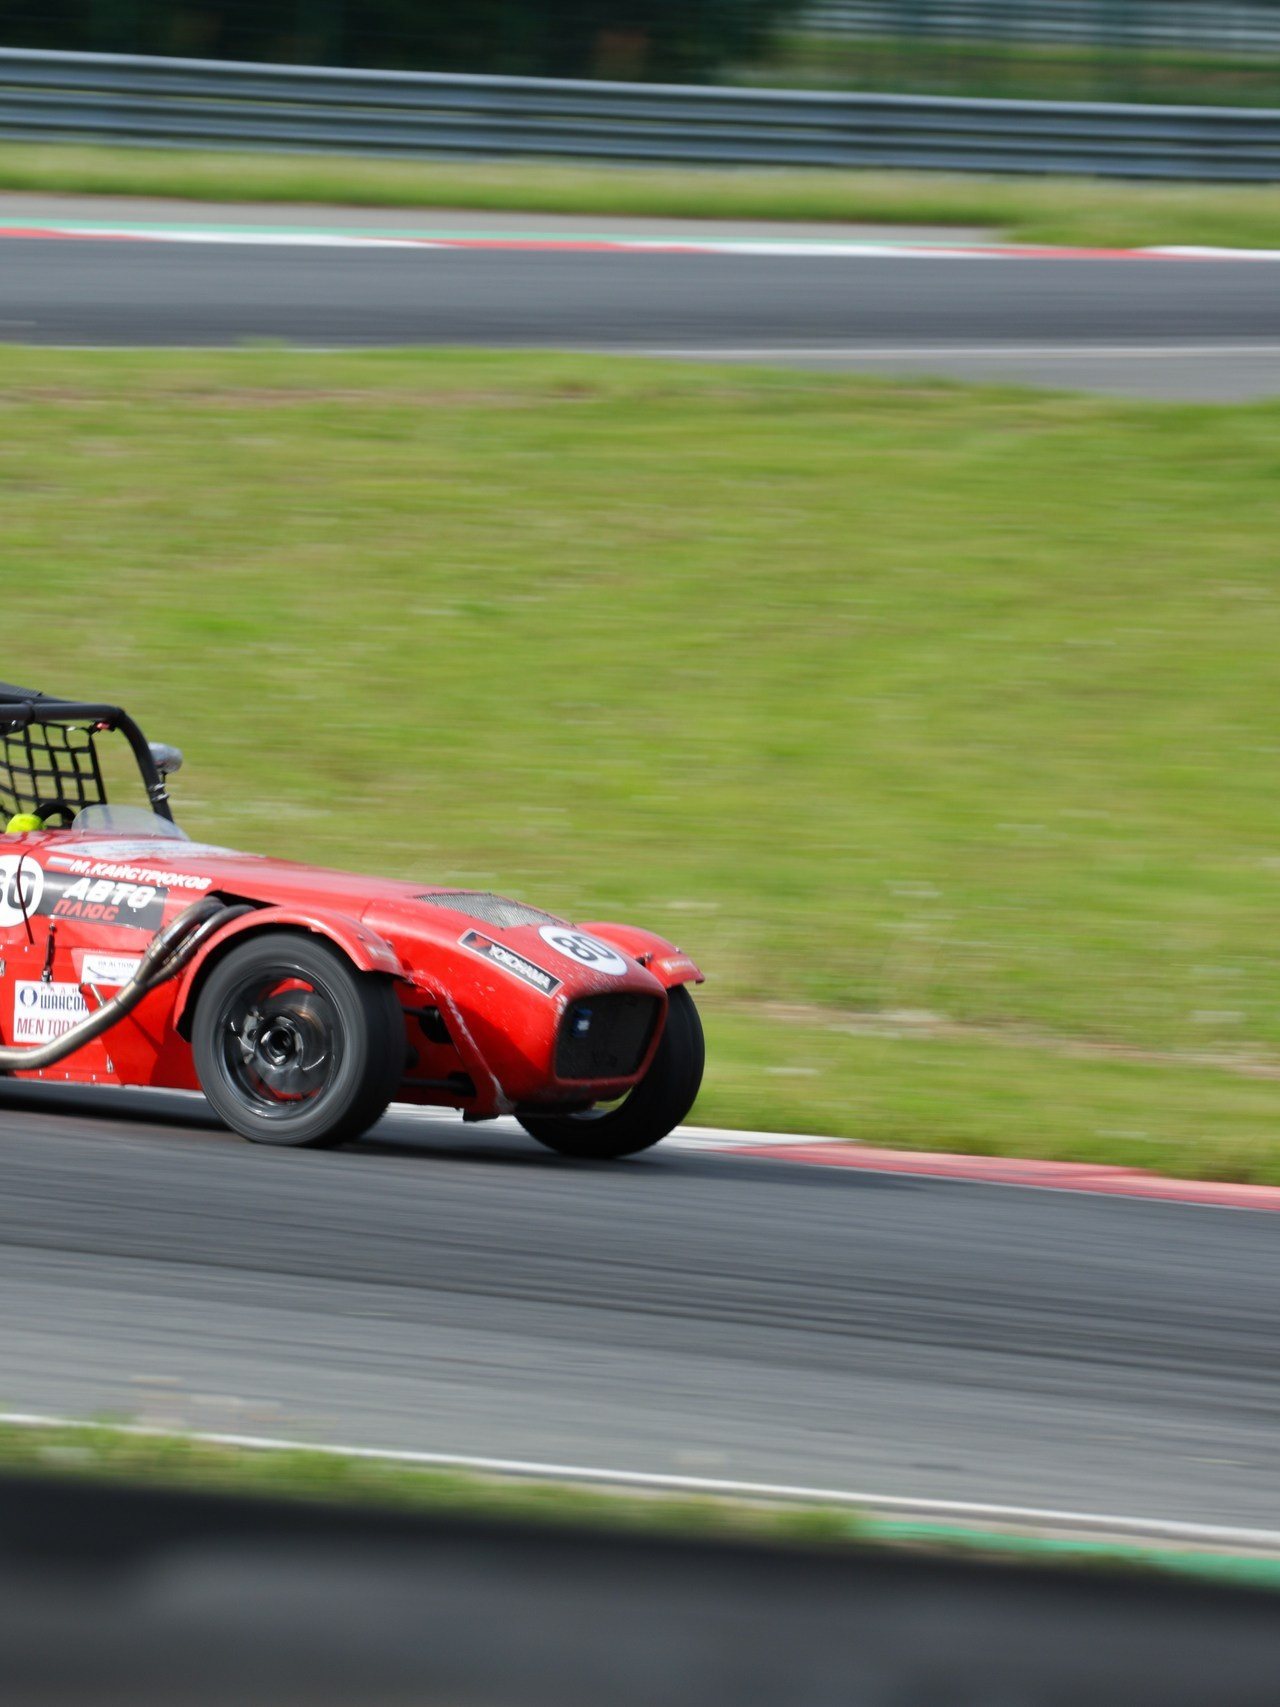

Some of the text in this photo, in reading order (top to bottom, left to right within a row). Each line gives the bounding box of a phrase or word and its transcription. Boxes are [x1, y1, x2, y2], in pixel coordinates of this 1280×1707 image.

[62, 877, 157, 909] АВТО
[52, 899, 119, 921] ПЛЮС
[551, 935, 618, 961] 80
[16, 1017, 45, 1036] MEN
